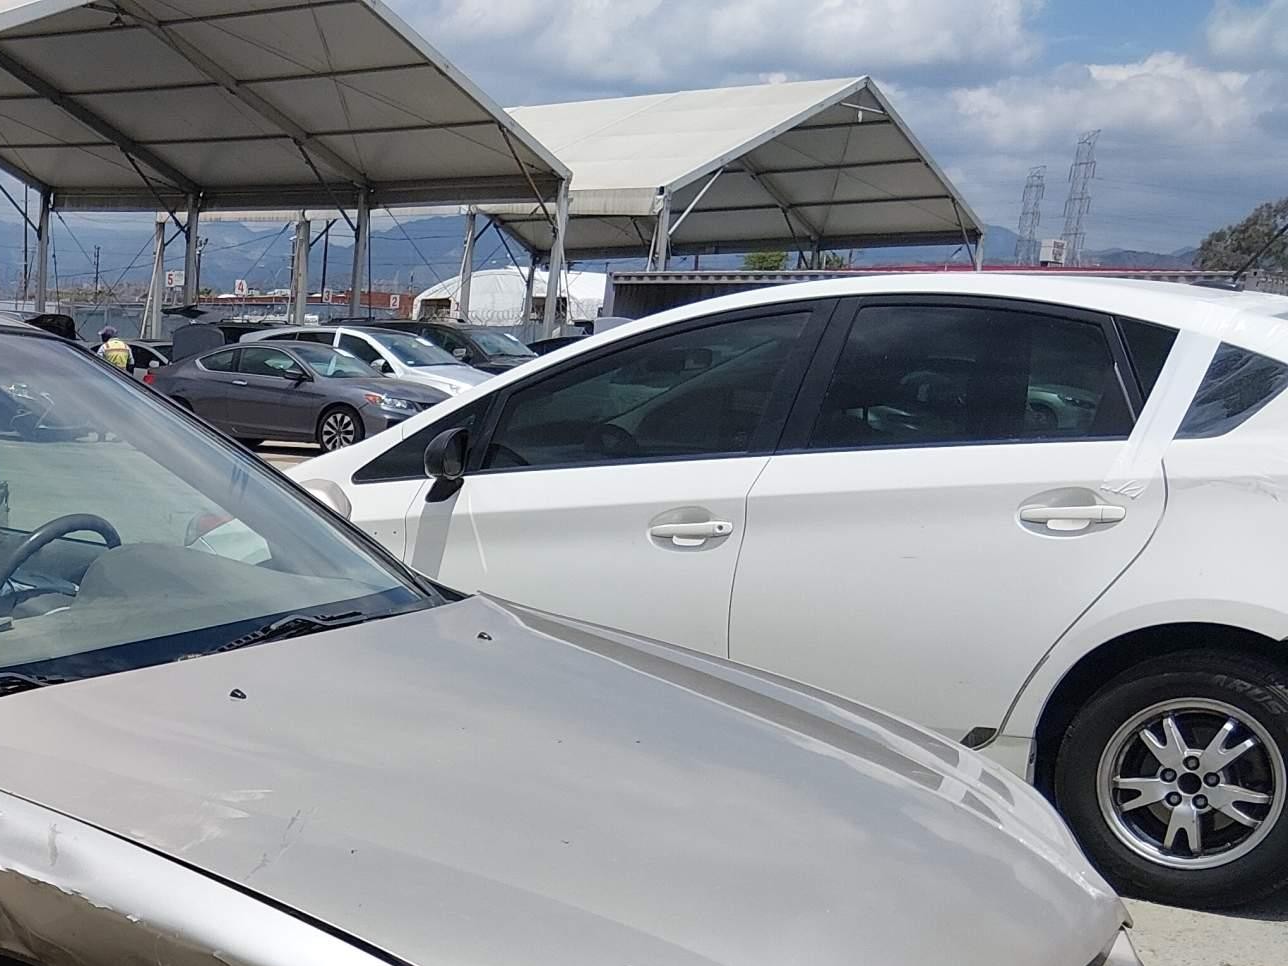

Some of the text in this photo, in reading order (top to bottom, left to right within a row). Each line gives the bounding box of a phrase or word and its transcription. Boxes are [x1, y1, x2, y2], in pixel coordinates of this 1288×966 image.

[167, 273, 174, 285] 5
[238, 280, 244, 292] 4
[324, 290, 331, 301] 3
[392, 297, 398, 307] 2
